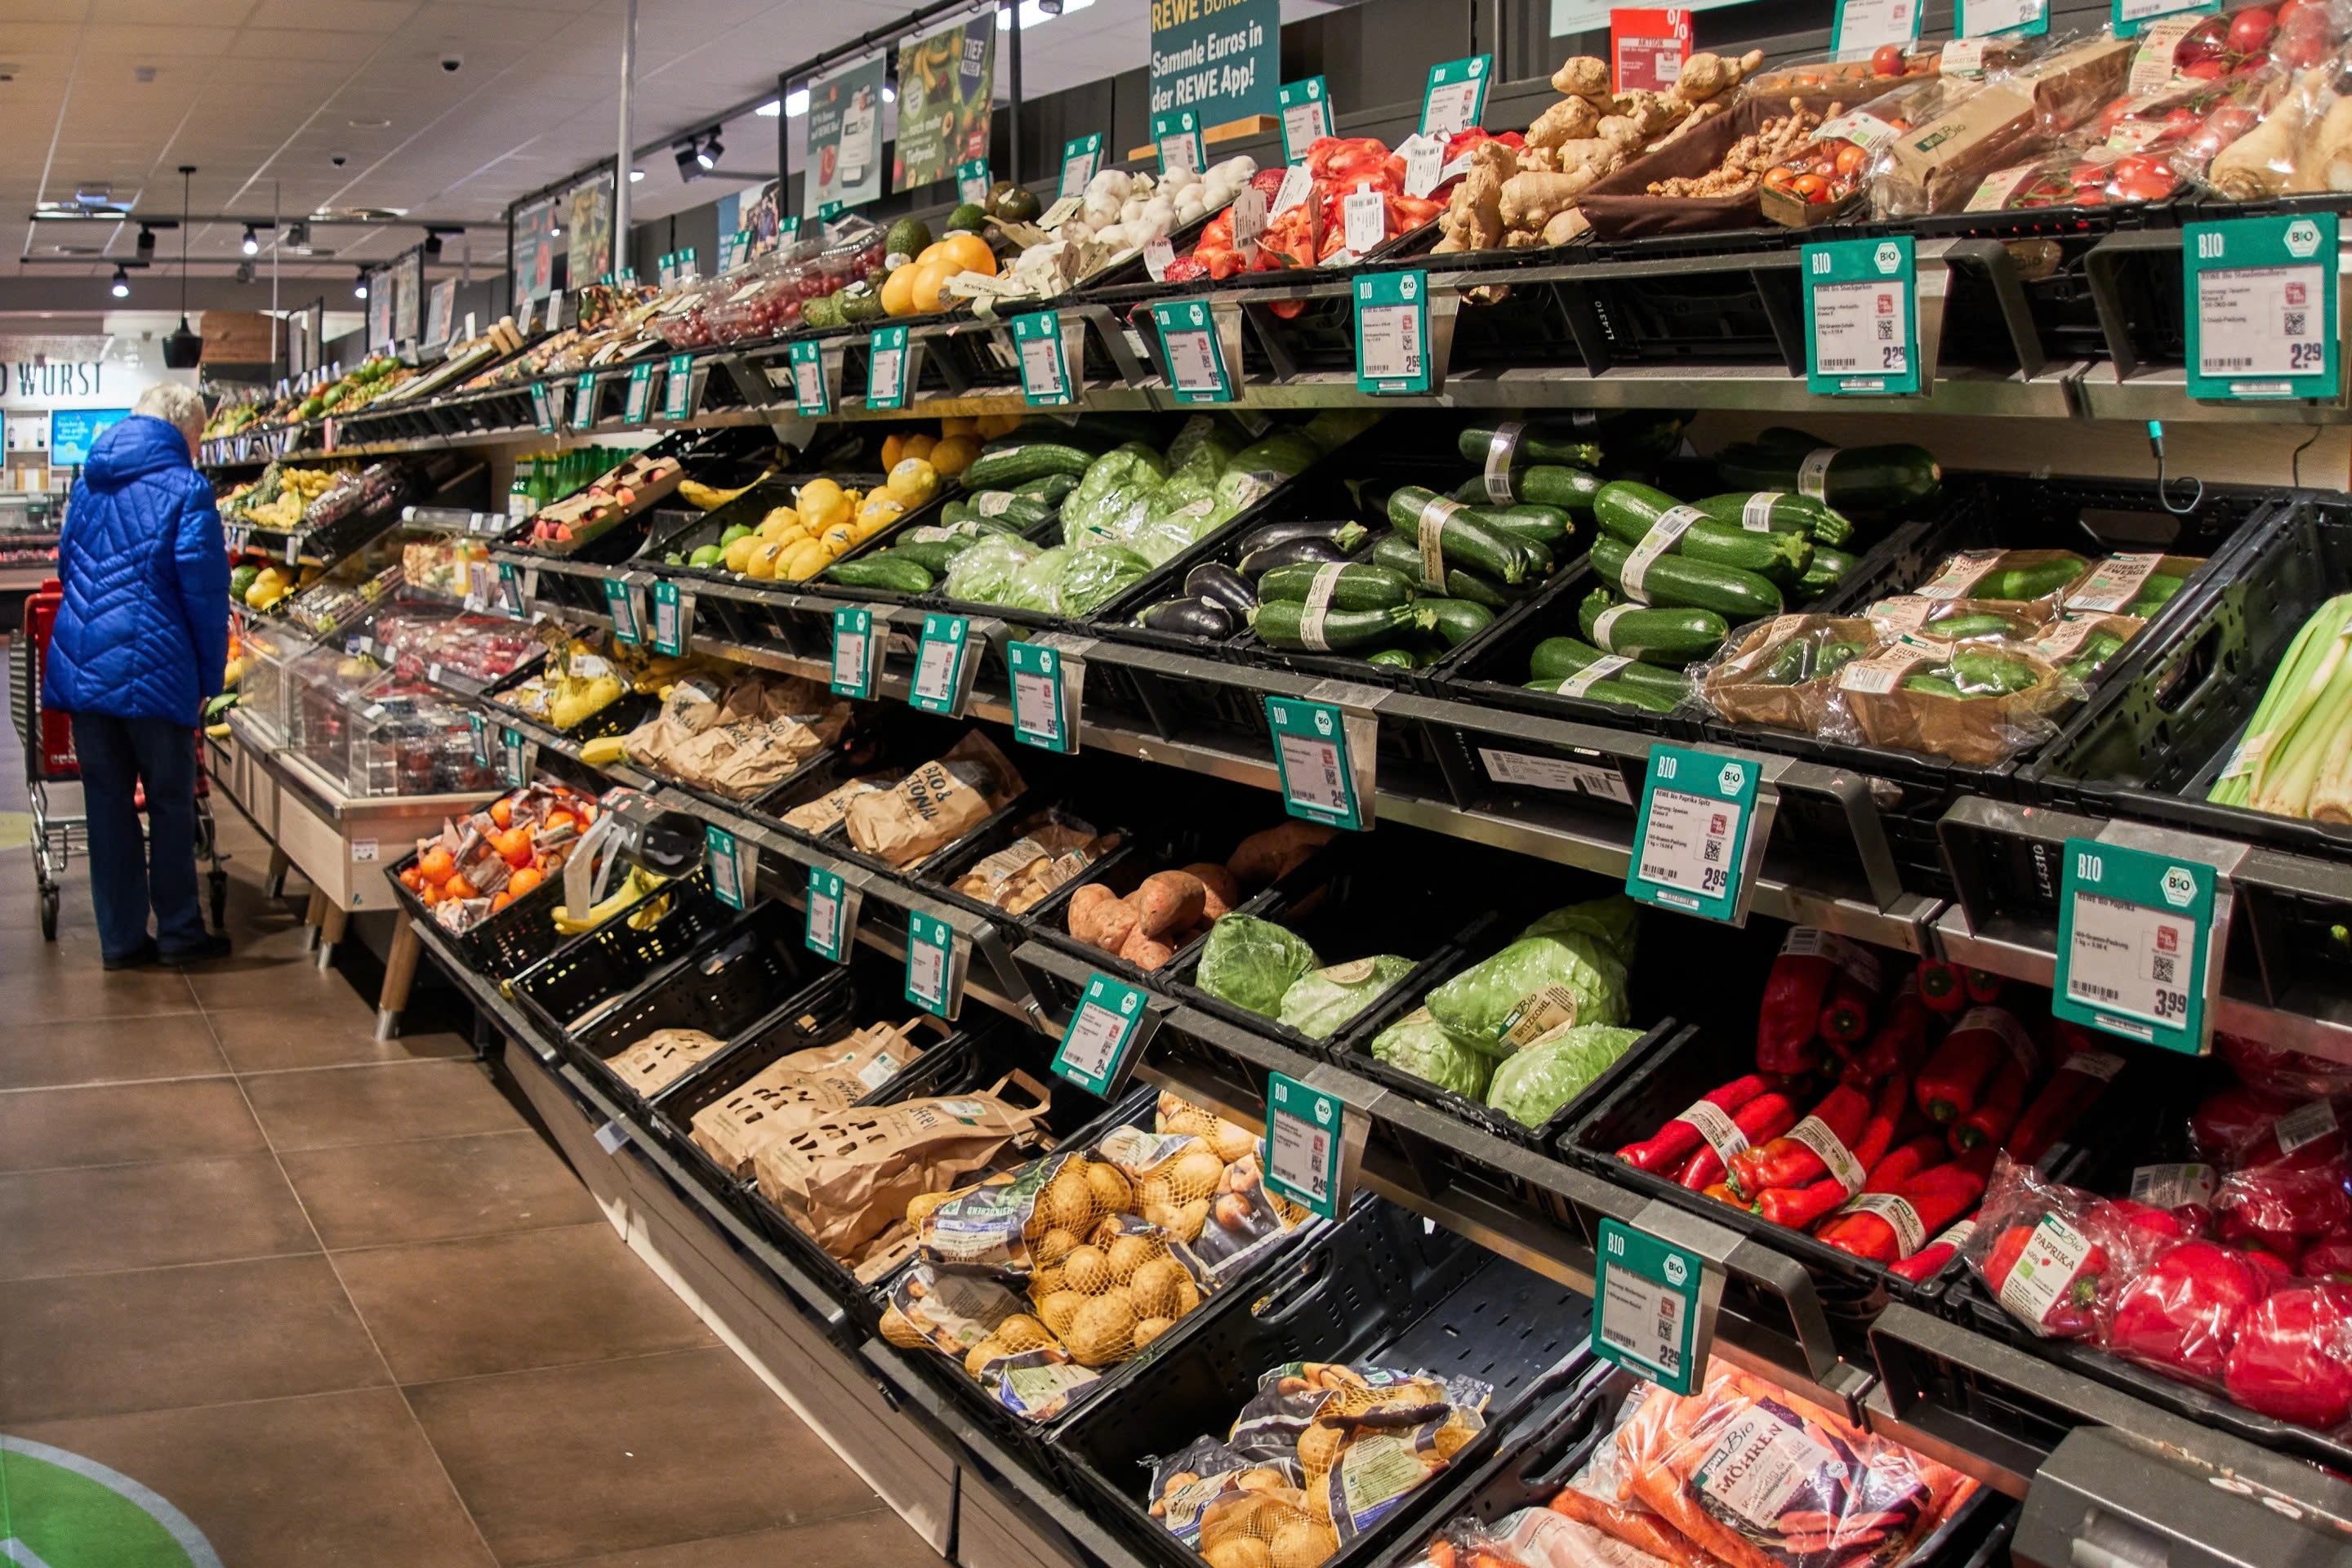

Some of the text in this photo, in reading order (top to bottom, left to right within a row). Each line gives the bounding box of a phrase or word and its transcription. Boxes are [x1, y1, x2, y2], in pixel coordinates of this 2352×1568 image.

[1152, 0, 1200, 33] REWE
[962, 35, 985, 60] TIEF
[1152, 20, 1263, 78] Sammle Euros in
[1152, 57, 1254, 113] der REWE App!
[2198, 233, 2223, 258] BIO
[1812, 252, 1831, 274] BIO
[1361, 283, 1372, 300] BIO
[1595, 301, 1615, 341] LL4310
[2291, 342, 2322, 369] 2.29
[18, 362, 103, 396] WURST
[1273, 707, 1287, 724] BIO
[923, 765, 946, 790] BIO
[1657, 755, 1677, 779] BIO
[1655, 790, 1710, 807] REWE Bio Paprika Spitz
[1702, 866, 1727, 892] 2.89
[2078, 853, 2102, 882] BIO
[2110, 900, 2135, 912] Paprika
[1519, 993, 1537, 1014] Bio
[2154, 988, 2187, 1018] 3.99
[1514, 1000, 1551, 1039] SPITZKOHL
[1276, 1083, 1287, 1102] BIO
[1608, 1232, 1624, 1257] BIO
[2034, 1233, 2074, 1271] PAPRIKA
[2060, 1232, 2083, 1252] Bio
[1659, 1344, 1680, 1368] 2.29
[1726, 1422, 1754, 1454] Bio
[1716, 1423, 1784, 1494] MÖHREN
